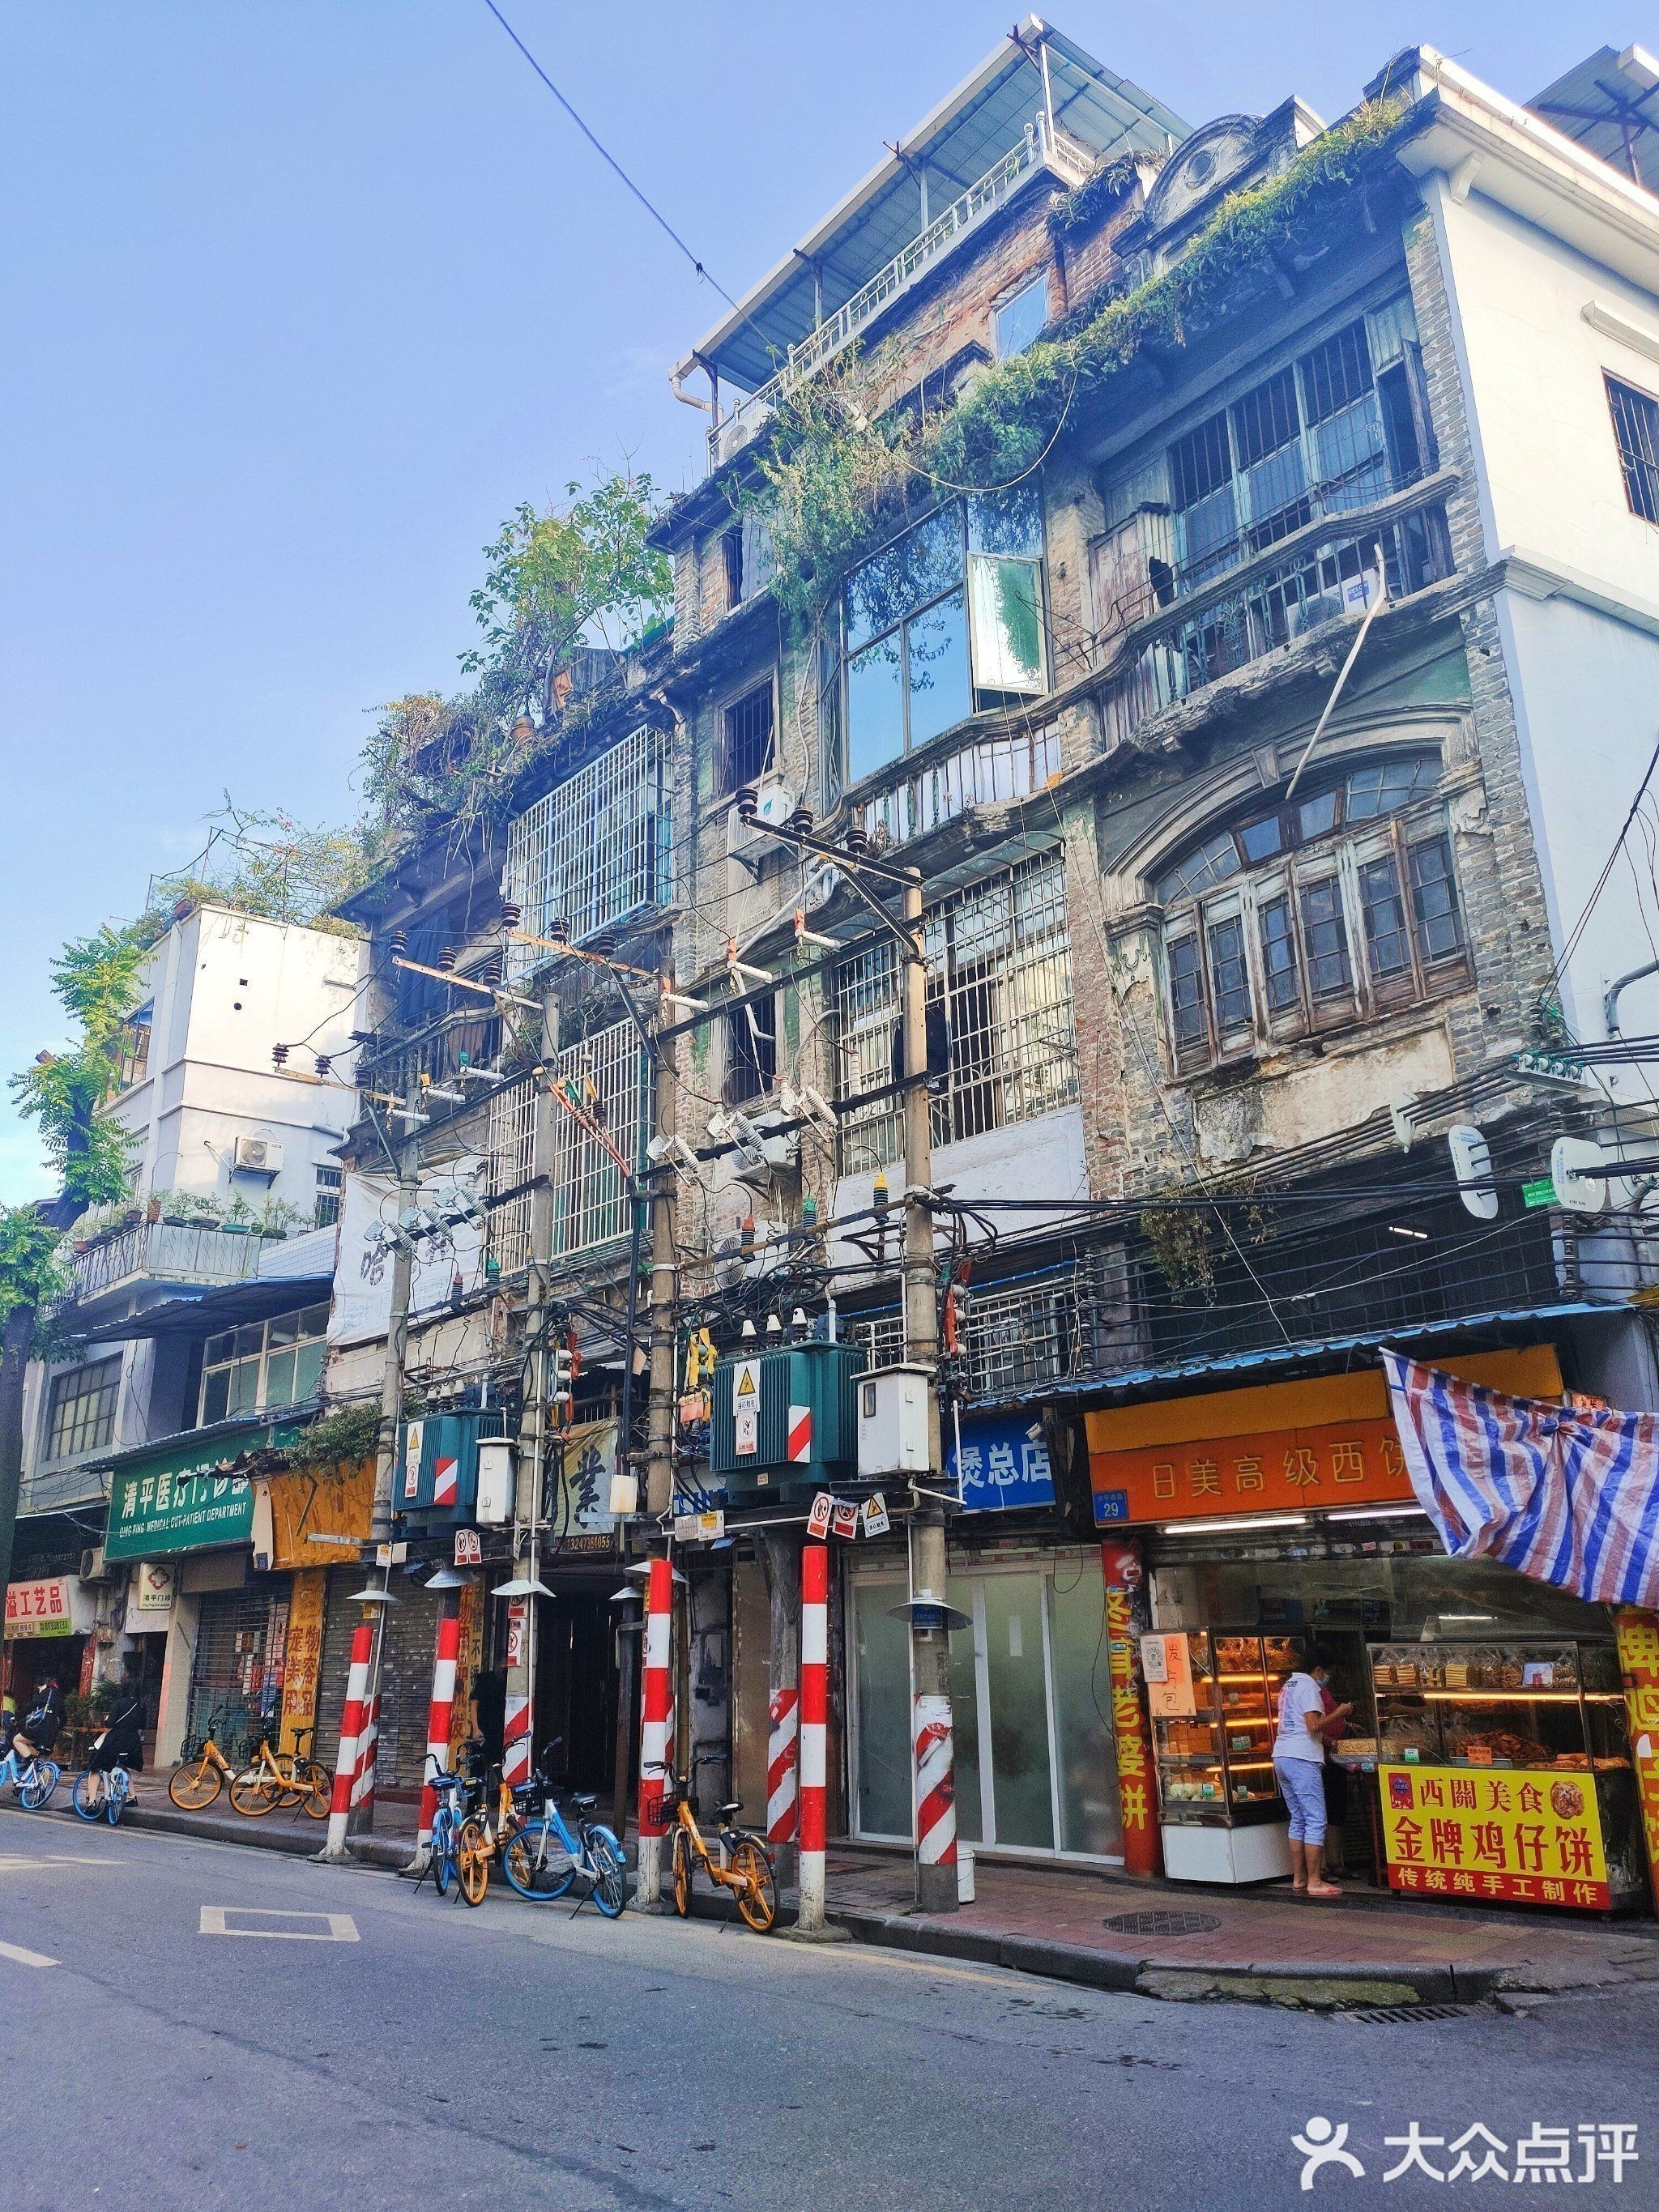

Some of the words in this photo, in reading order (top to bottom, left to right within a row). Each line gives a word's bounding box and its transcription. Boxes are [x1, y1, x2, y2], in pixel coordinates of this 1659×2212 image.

[147, 1518, 169, 1532] MEDICAL
[170, 1509, 207, 1528] OUT-PATIENT
[207, 1502, 247, 1521] DEPARTMENT
[1103, 1502, 1118, 1517] 29
[1418, 1778, 1544, 1814] 西關美食
[1392, 1816, 1594, 1877] 金牌鸡仔饼
[1398, 1868, 1597, 1904] 传统纯手工制作
